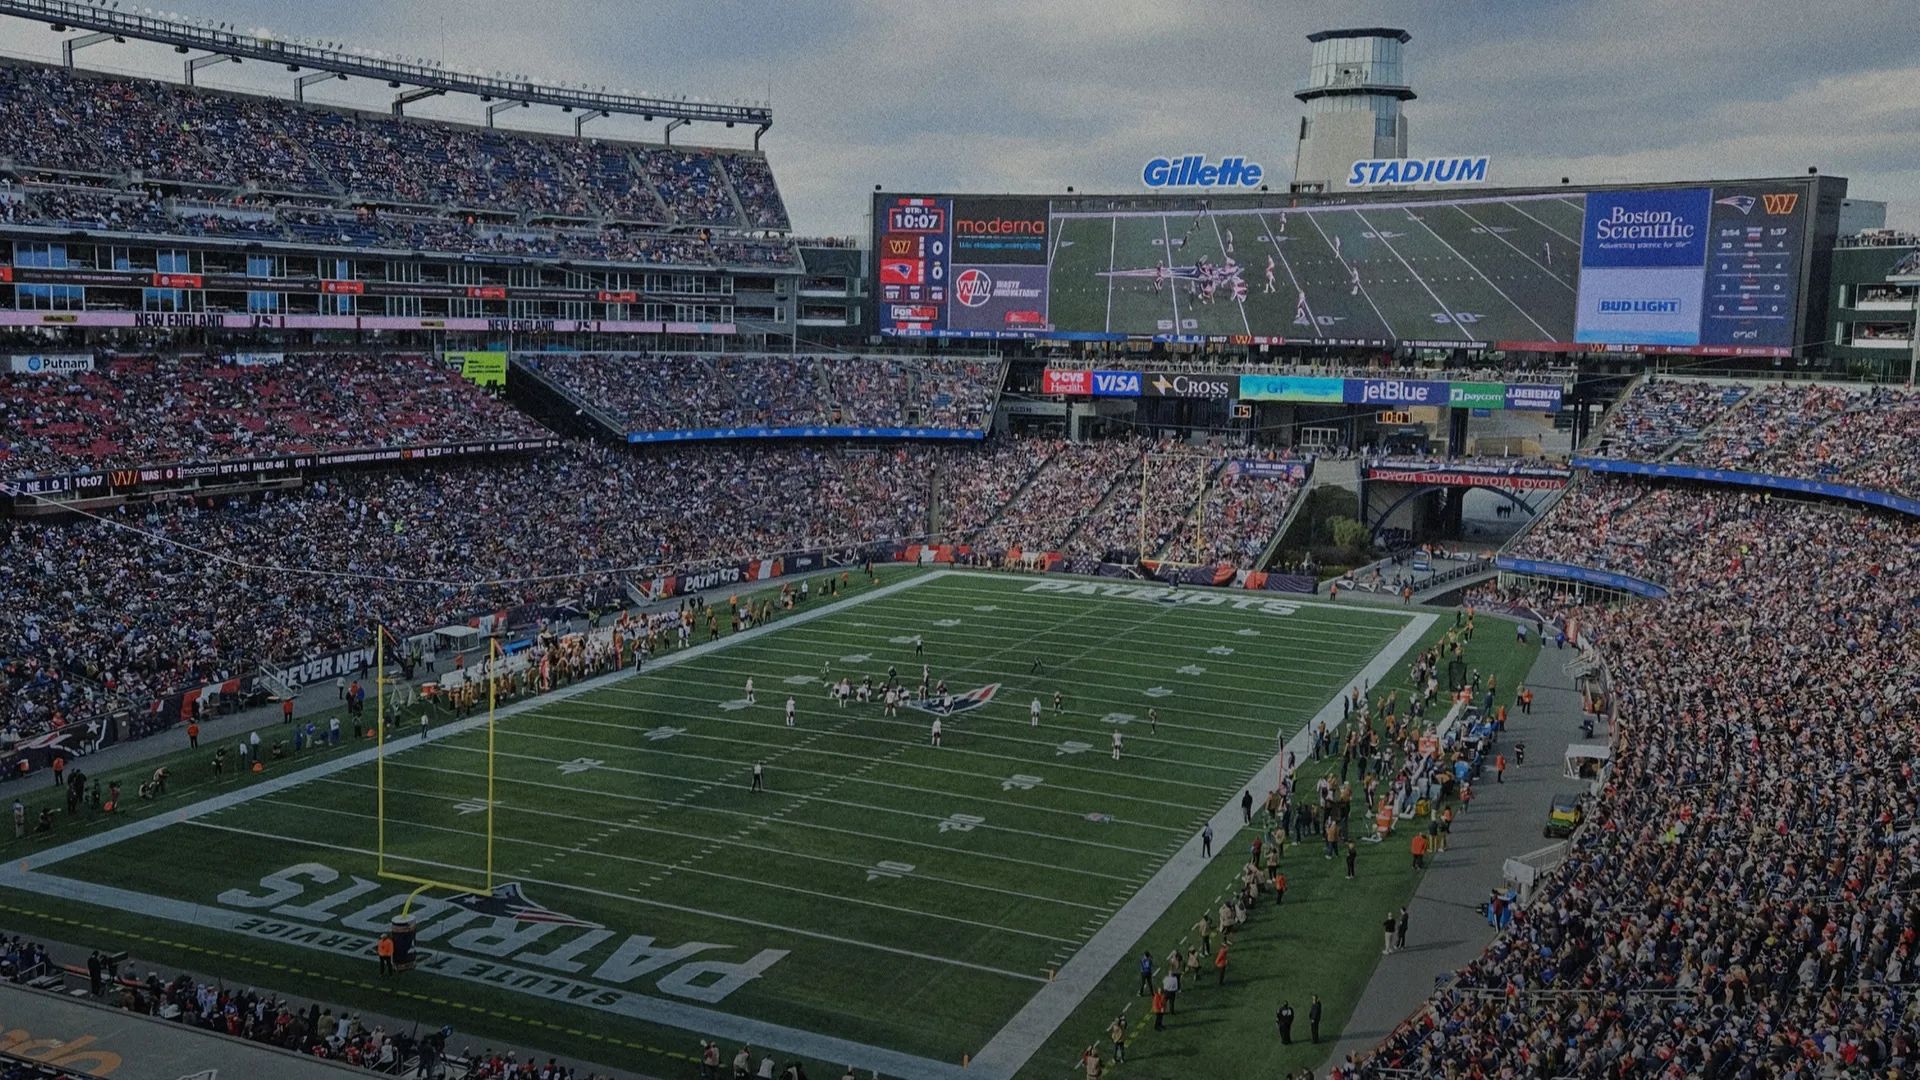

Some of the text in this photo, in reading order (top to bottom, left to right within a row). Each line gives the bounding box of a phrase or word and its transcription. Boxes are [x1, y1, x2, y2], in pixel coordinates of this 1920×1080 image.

[1142, 155, 1488, 187] Gillette STADIUM
[895, 214, 938, 228] 10:07
[1611, 206, 1672, 225] Boston
[956, 216, 1045, 234] moderna
[1597, 216, 1694, 240] Scientific
[932, 240, 943, 255] 0
[932, 266, 943, 280] 0
[959, 279, 988, 297] WIN
[1600, 301, 1678, 312] BUD LIGHT
[134, 313, 225, 328] NEW ENGLAND
[487, 319, 555, 332] NEW ENGLAND
[42, 358, 88, 371] Putnam
[1050, 381, 1084, 392] Health
[1060, 372, 1084, 383] CVS
[1095, 374, 1140, 392] VISA
[1361, 380, 1429, 403] jetBlue
[1463, 393, 1502, 403] paycom
[1505, 388, 1561, 400] J.DERENZO
[26, 481, 41, 493] NE
[51, 479, 60, 490] 0
[75, 475, 103, 487] 10:07
[140, 469, 160, 481] WAS
[166, 469, 173, 479] 0
[1375, 470, 1562, 489] TOYOTA TOYOTA TOYOTA TOYOTA
[684, 567, 740, 592] PATRIOTS
[1022, 580, 1300, 616] PATRIOTS
[217, 862, 792, 1004] PATRIOTS
[460, 962, 623, 1006] SALUTE
